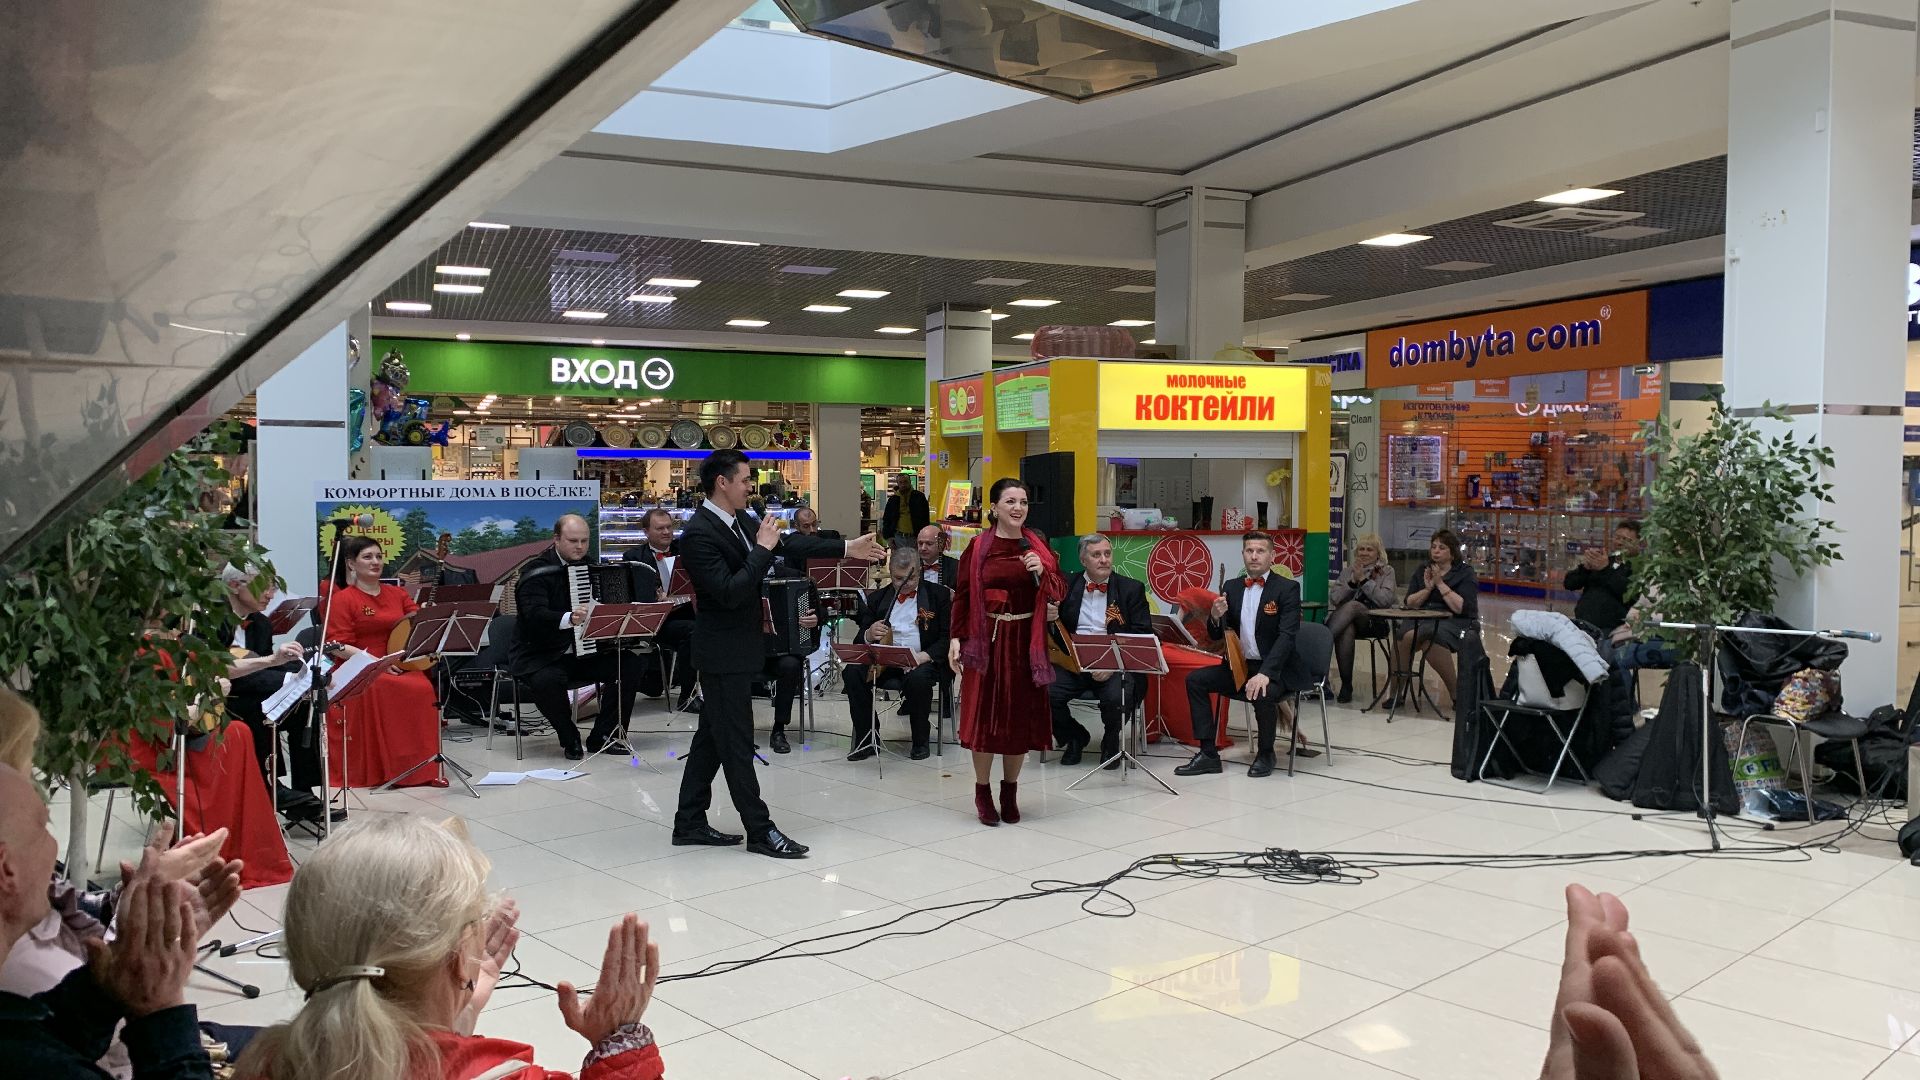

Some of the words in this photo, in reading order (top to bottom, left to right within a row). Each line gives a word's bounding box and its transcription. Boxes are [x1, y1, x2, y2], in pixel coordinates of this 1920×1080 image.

[1389, 324, 1516, 368] dombyta
[1526, 318, 1602, 352] com
[551, 357, 638, 389] ВХОД
[1350, 414, 1372, 424] Clean
[324, 487, 445, 499] КОМФОРТНЫЕ
[449, 487, 496, 499] ДОМА
[501, 487, 510, 497] В
[515, 484, 592, 498] ПОСЁЛКЕ!
